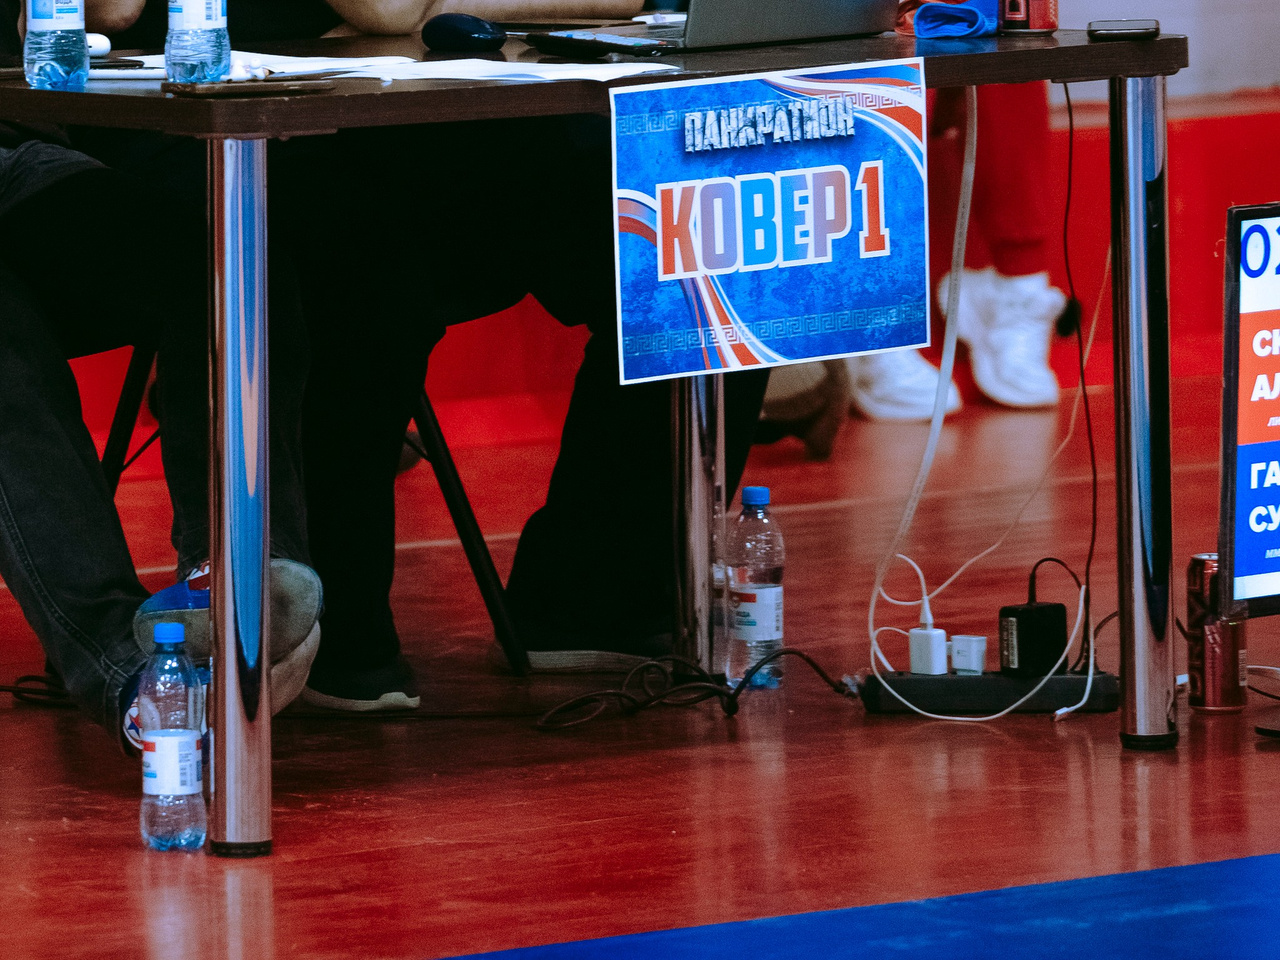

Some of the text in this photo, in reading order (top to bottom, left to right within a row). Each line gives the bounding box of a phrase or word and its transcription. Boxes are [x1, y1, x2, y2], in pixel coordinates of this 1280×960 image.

[685, 97, 856, 153] ПАНКРАТИОН
[656, 160, 890, 281] КОВЕР 1
